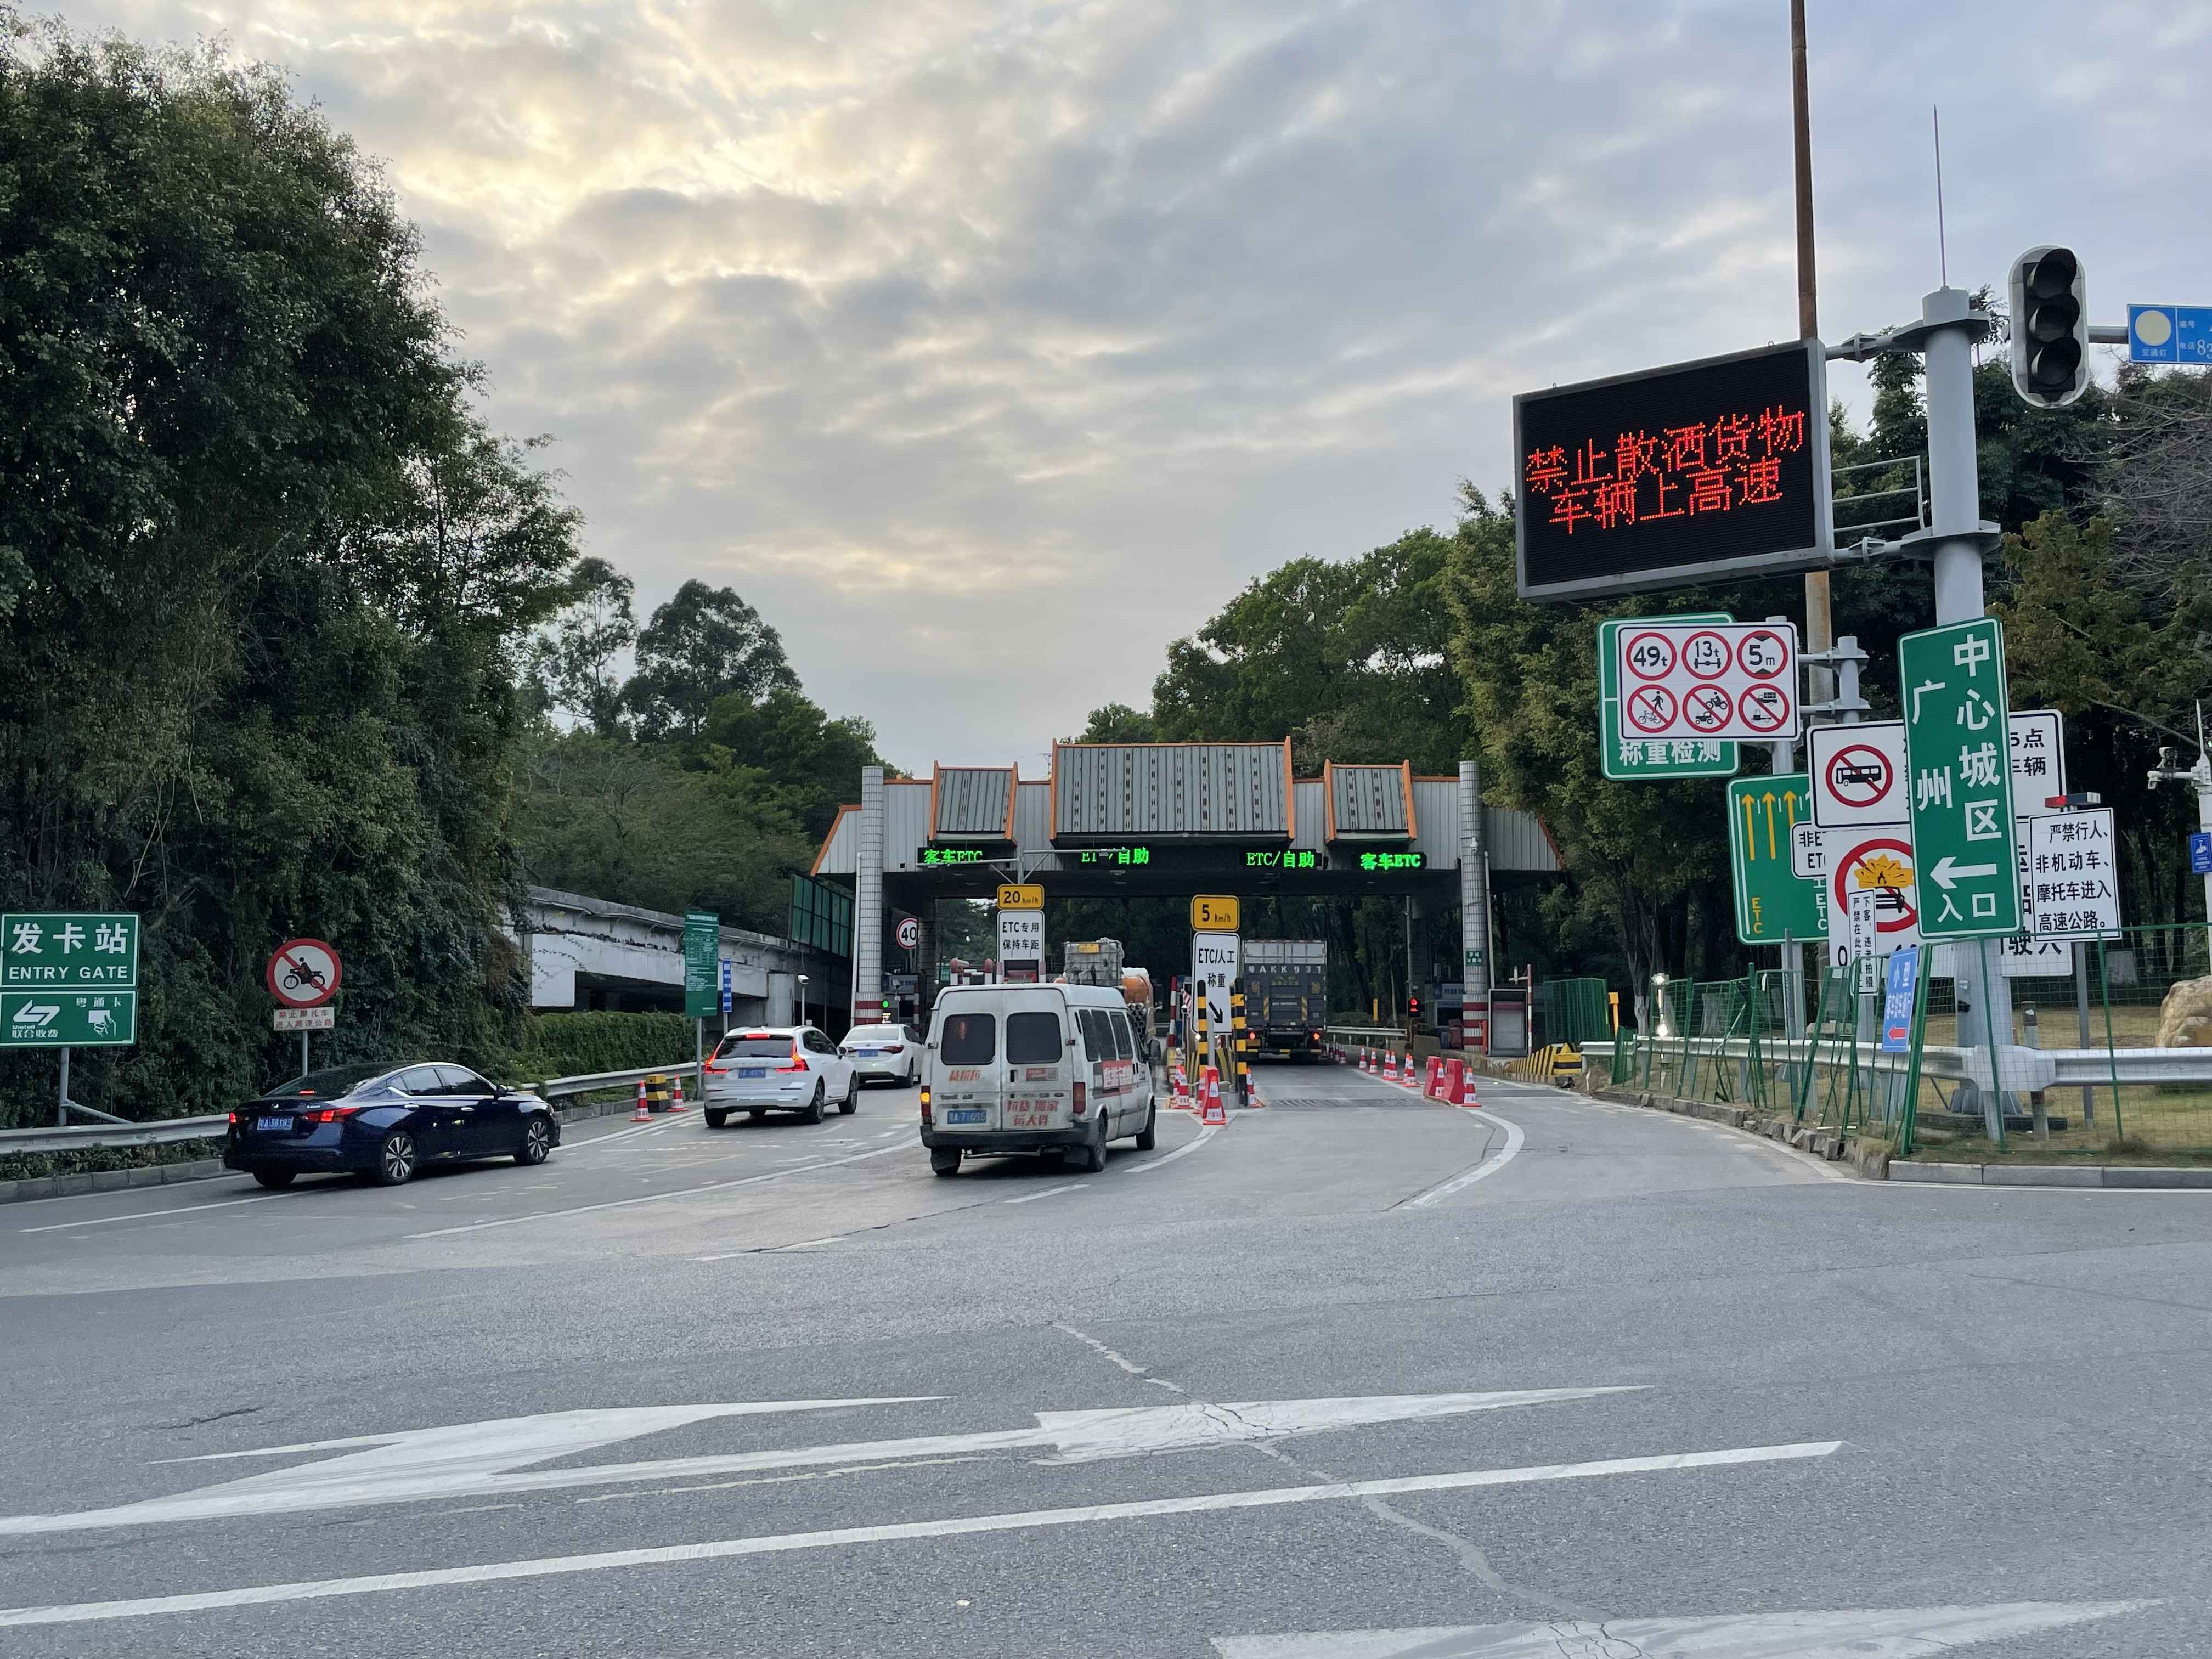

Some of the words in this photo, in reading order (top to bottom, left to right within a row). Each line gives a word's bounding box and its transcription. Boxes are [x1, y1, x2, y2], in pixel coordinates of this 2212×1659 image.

[1549, 456, 1782, 535] 车辆上高速
[1633, 646, 1668, 667] 49t
[1695, 640, 1719, 658] 13t
[1912, 679, 1954, 812] 广州
[1953, 633, 2002, 842] 中心城区
[1620, 741, 1722, 767] 称重检测
[1360, 852, 1421, 870] 客车ETC
[1003, 891, 1020, 904] 20
[2036, 879, 2112, 903] 摩托车进入
[1202, 904, 1210, 922] 5
[1752, 897, 1763, 934] ETC
[1937, 892, 1997, 923] 入口
[901, 927, 916, 940] 40
[1002, 922, 1040, 933] ETC专用
[11, 922, 129, 955] 发卡站
[1003, 939, 1040, 950] 保持车距
[1198, 949, 1234, 964] ETC/人工
[9, 966, 70, 979] ENTRY
[79, 966, 128, 979] GATE
[1207, 973, 1226, 988] 称重
[12, 1029, 58, 1039] 联合收费
